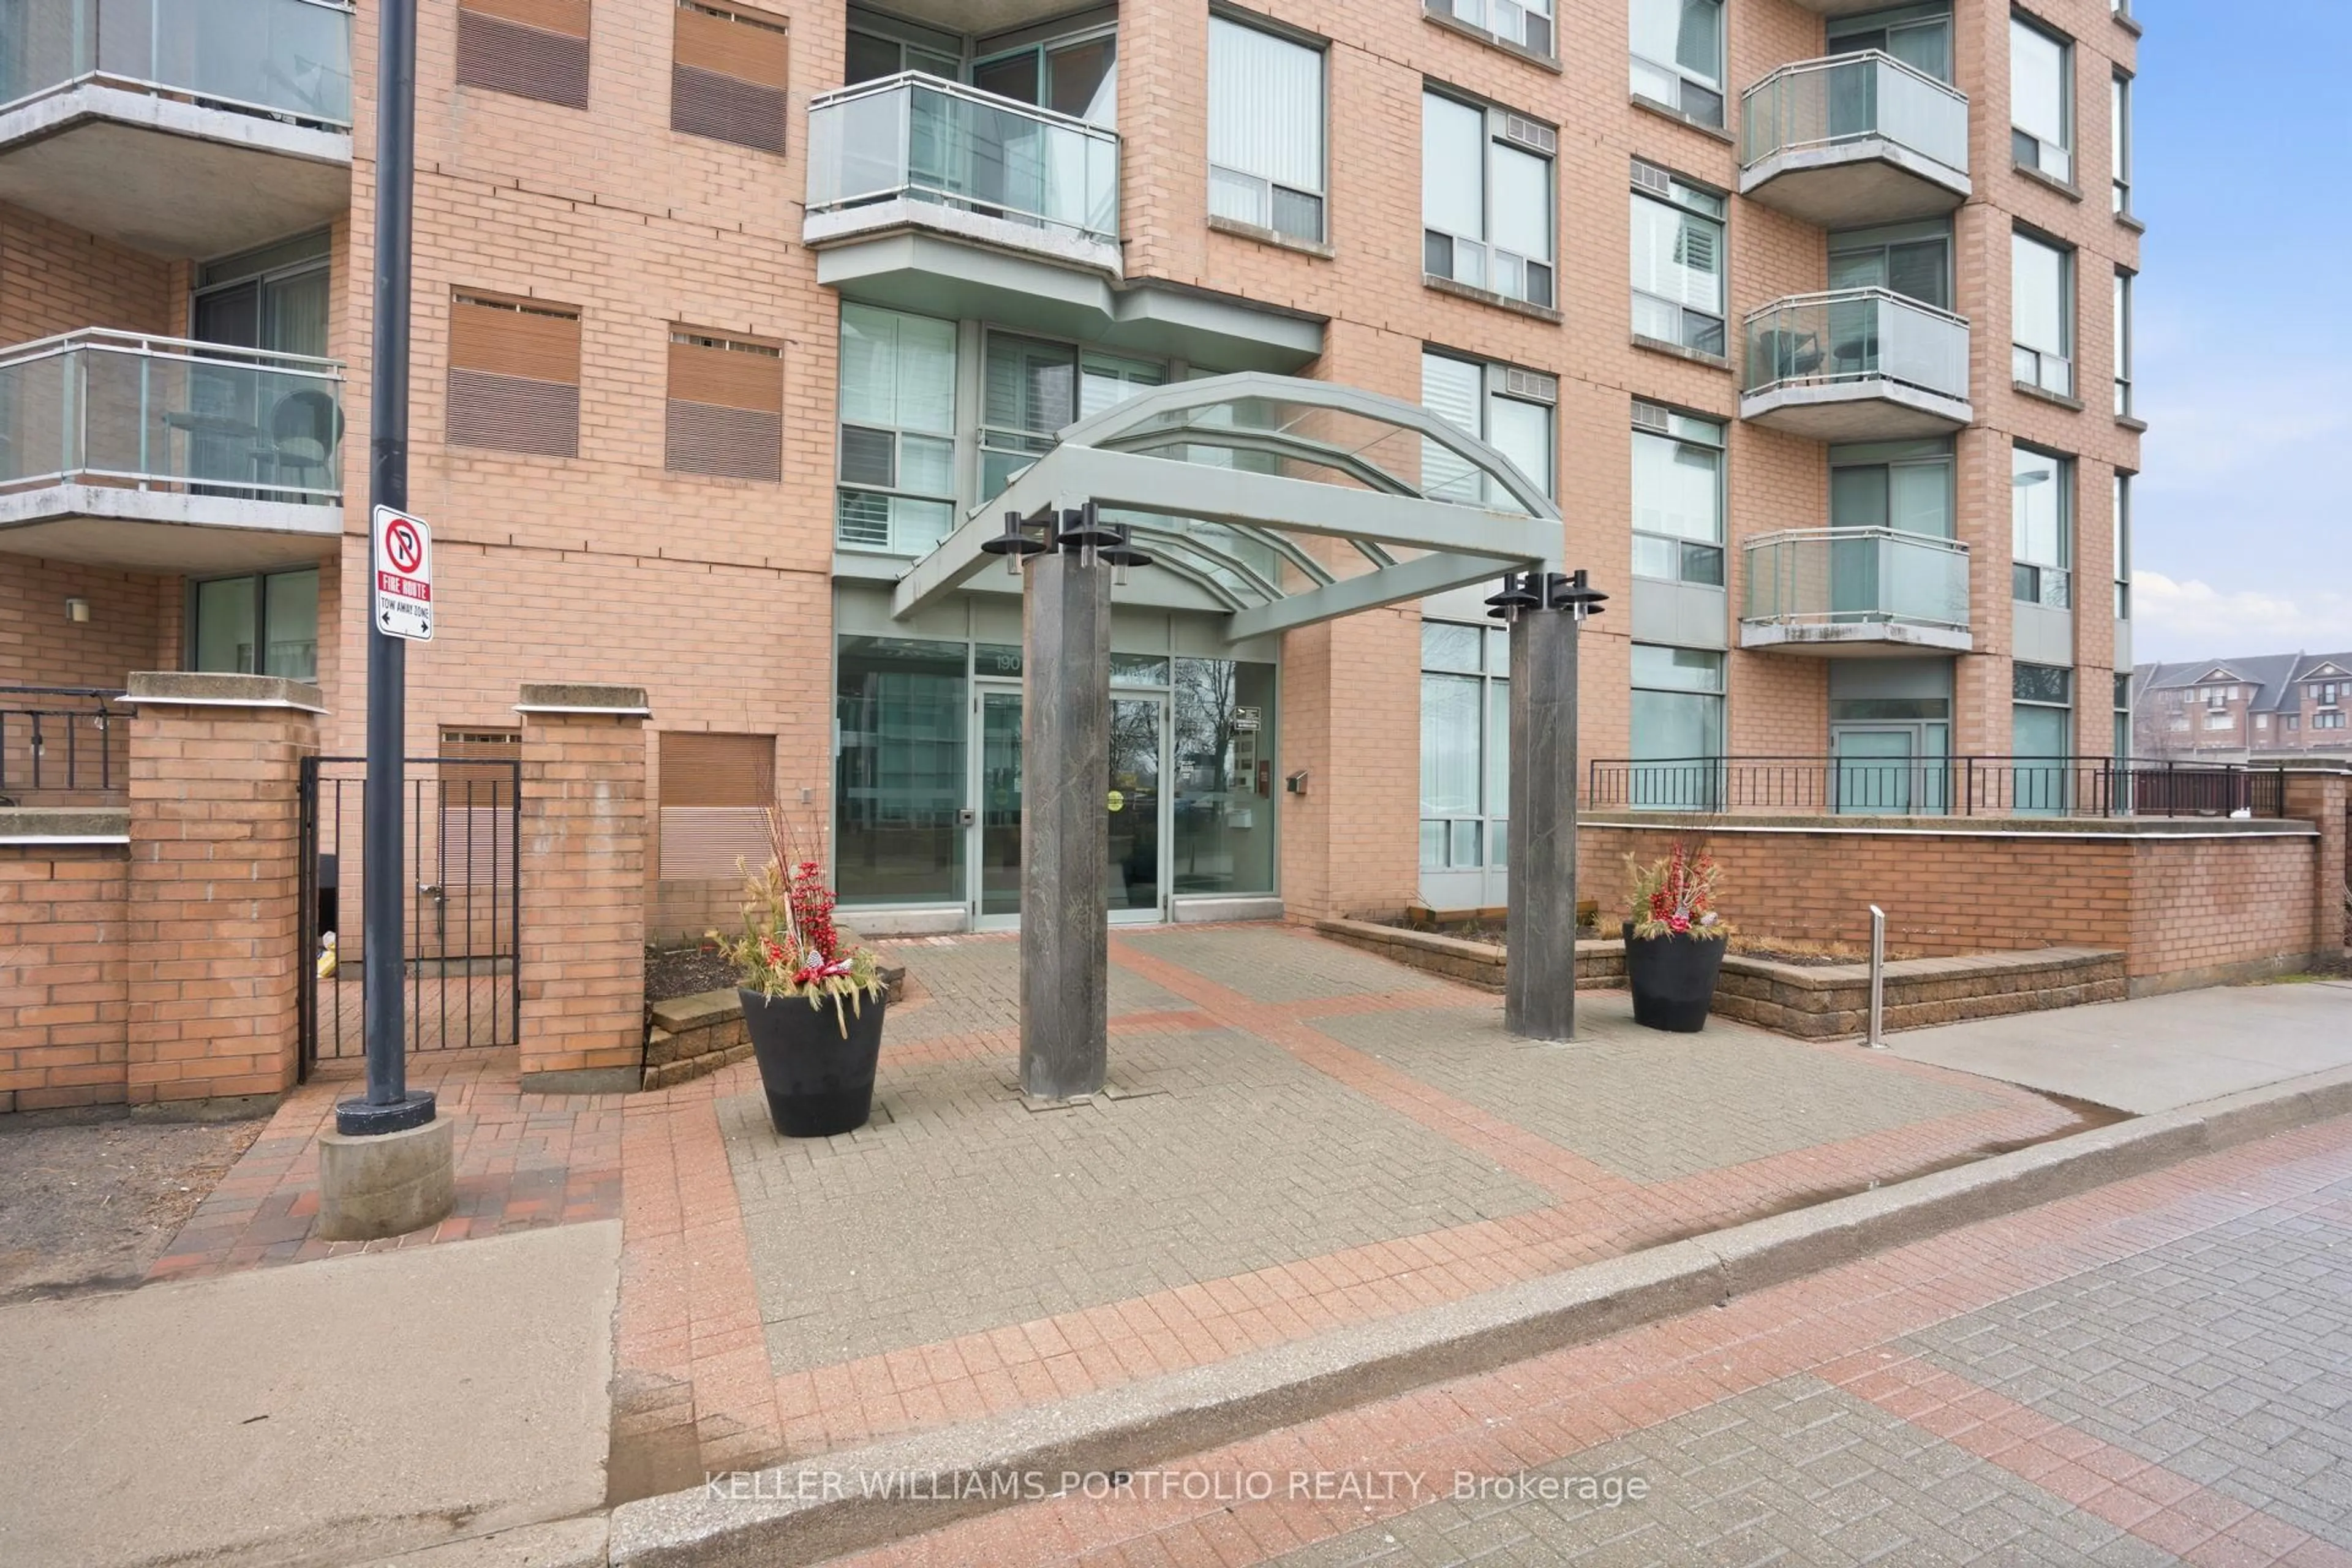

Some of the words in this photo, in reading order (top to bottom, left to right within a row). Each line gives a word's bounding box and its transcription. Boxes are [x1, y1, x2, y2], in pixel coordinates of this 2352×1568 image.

[383, 574, 400, 594] FIRE
[402, 579, 426, 599] ROUTE
[382, 597, 396, 610] TOW
[397, 601, 413, 614] AWAY
[413, 605, 428, 619] ZONE
[996, 655, 1020, 671] 190
